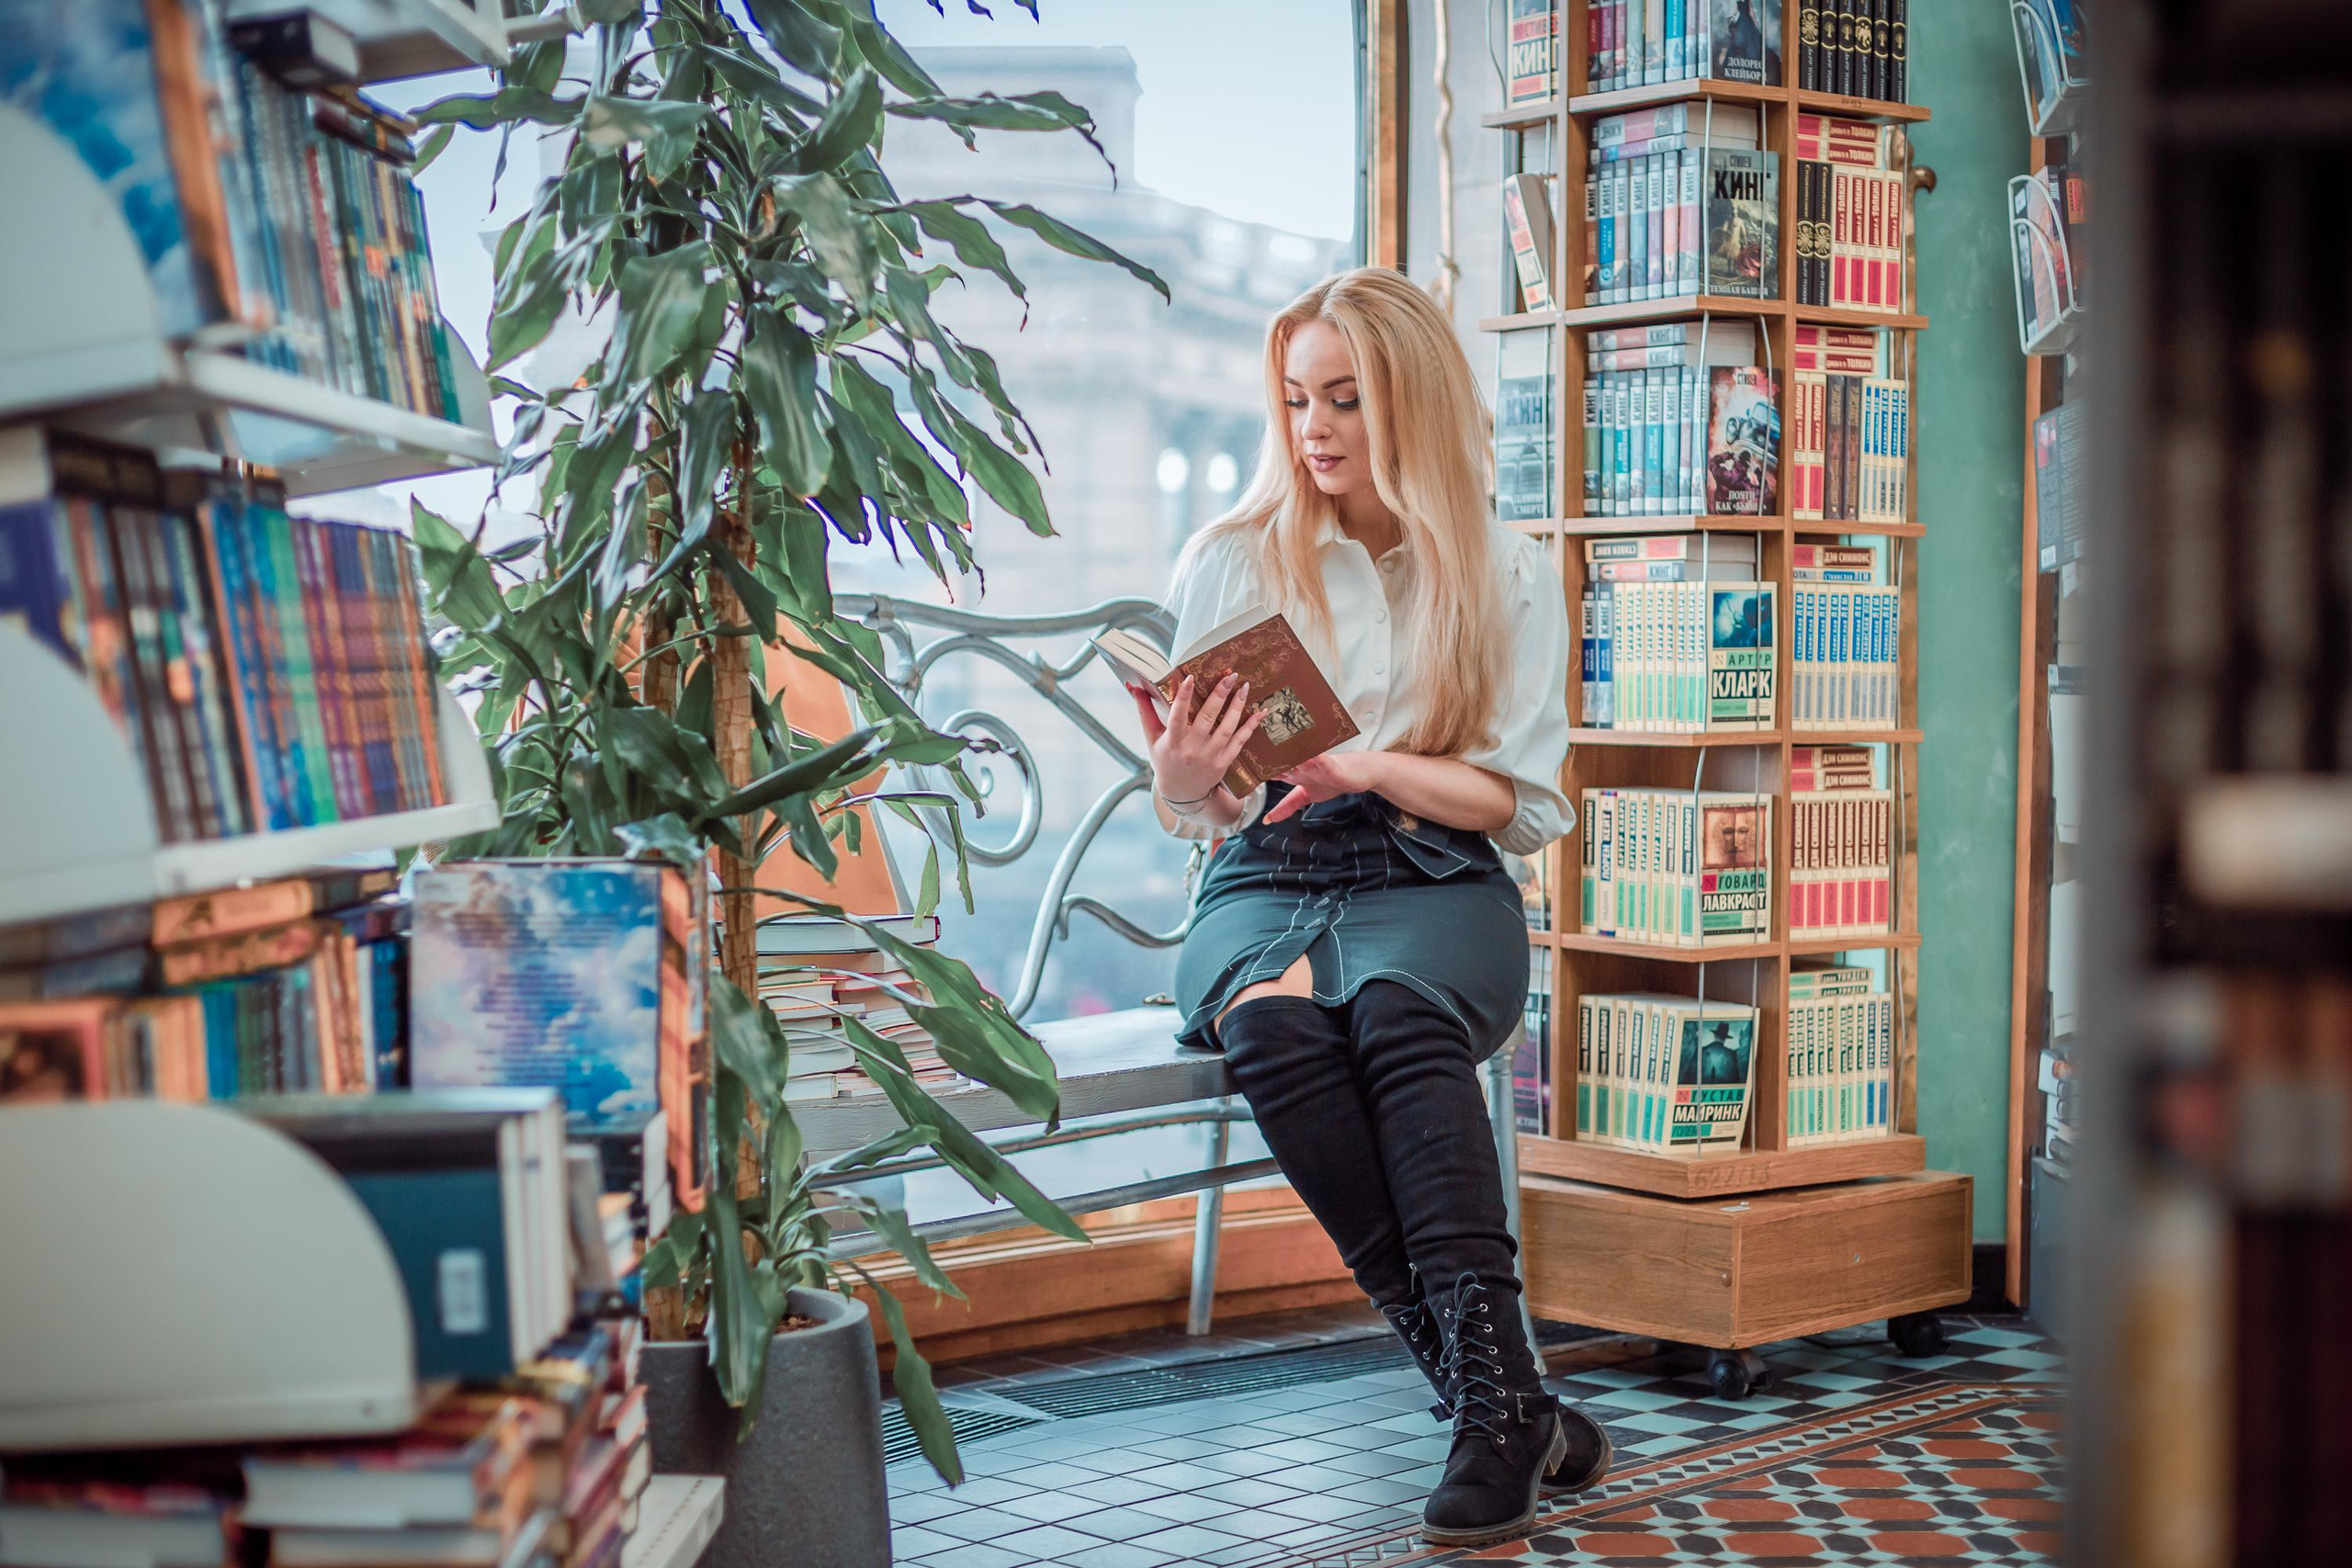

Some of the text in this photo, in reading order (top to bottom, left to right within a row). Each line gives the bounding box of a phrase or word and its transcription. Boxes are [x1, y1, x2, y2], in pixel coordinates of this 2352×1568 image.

[1514, 38, 1559, 76] КИНГ
[1724, 68, 1767, 82] КЛЕЙБОР
[1602, 185, 1611, 215] КИНГ
[1616, 183, 1624, 212] КИНГ
[1634, 181, 1645, 210] КИНГ
[1651, 178, 1659, 207] КИНГ
[1666, 174, 1675, 204] КИНГ
[1685, 172, 1695, 201] КИНГ
[1714, 170, 1771, 202] КИНГ
[1871, 181, 1880, 217] ТОЛКИН
[1588, 187, 1596, 218] КИНГ
[1890, 184, 1898, 218] ТОЛКИН
[1741, 286, 1769, 296] БАШЯ
[1506, 396, 1543, 425] КИН
[1585, 394, 1596, 423] КИНГ
[1617, 395, 1627, 425] КИНГ
[1633, 391, 1642, 421] КИНГ
[1649, 390, 1659, 422] КИНГ
[1666, 391, 1676, 420] КИНГ
[1795, 385, 1804, 421] ТОЛКИН
[1814, 386, 1822, 422] ТОЛКИН
[1715, 502, 1731, 511] КАК
[1584, 605, 1593, 635] КИНГ
[1600, 605, 1609, 634] КИНГ
[1713, 671, 1771, 698] КЛАРК
[1825, 774, 1870, 787] ДЭН СИММОНС
[1602, 811, 1611, 879] ЛОРЕН КЕНТ
[1719, 874, 1765, 889] ГОВАРД
[1703, 892, 1765, 912] ЛАВКРАФТ
[1691, 1089, 1744, 1103] ГУСТАВ
[1674, 1104, 1741, 1122] МАЙРИНК
